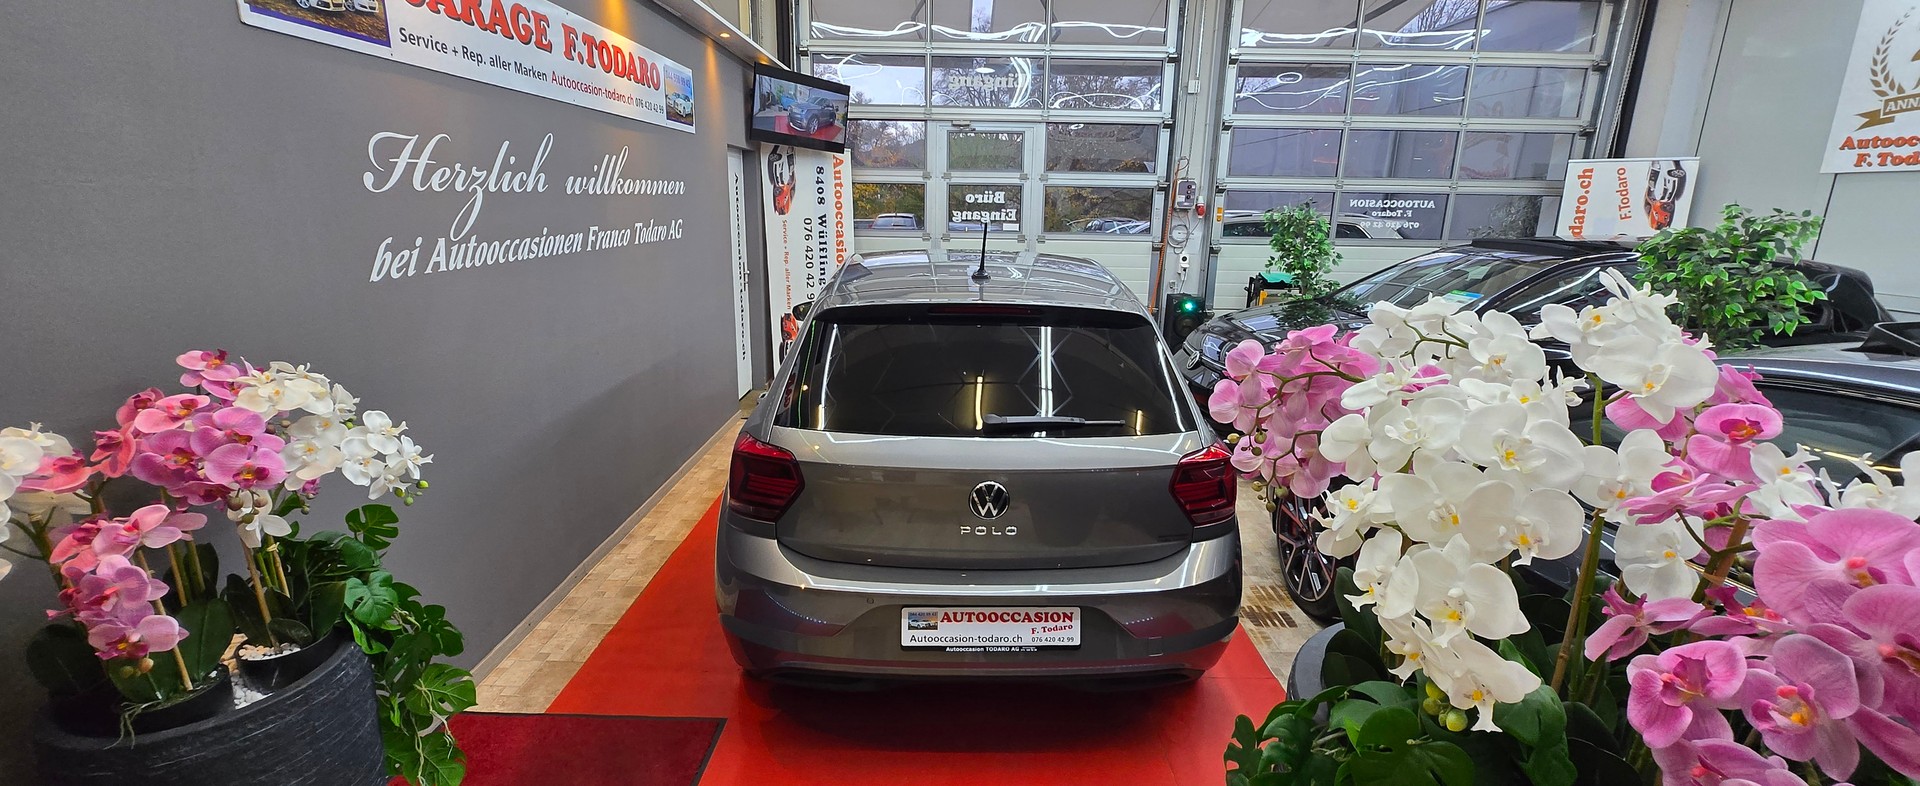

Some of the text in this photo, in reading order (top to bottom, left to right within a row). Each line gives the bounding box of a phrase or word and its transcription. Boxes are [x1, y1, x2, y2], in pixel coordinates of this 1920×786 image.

[399, 27, 448, 55] Service
[451, 46, 459, 57] +
[462, 45, 487, 67] Rep.
[489, 55, 512, 72] aller
[513, 61, 548, 82] Marken
[551, 70, 634, 107] Autooccasion-todaro.ch
[634, 97, 644, 109] 076
[404, 0, 661, 92] RAGE F.TODARO
[1839, 135, 1920, 150] Autooc
[1853, 151, 1920, 168] F. Tod
[362, 131, 686, 242] Herzlich willkommen
[815, 165, 829, 290] 8408 Wülfling
[832, 153, 848, 269] Autooccasio
[369, 218, 684, 283] bei Autooccasionen Franco Todaro AG
[803, 217, 817, 303] 076 420 42 9
[785, 284, 793, 310] Marken
[960, 526, 1017, 536] POLO
[909, 634, 1023, 643] Autooccasion-todaro.ch
[940, 611, 1075, 623] AUTOOCCASION
[1031, 624, 1074, 635] F. Todaro
